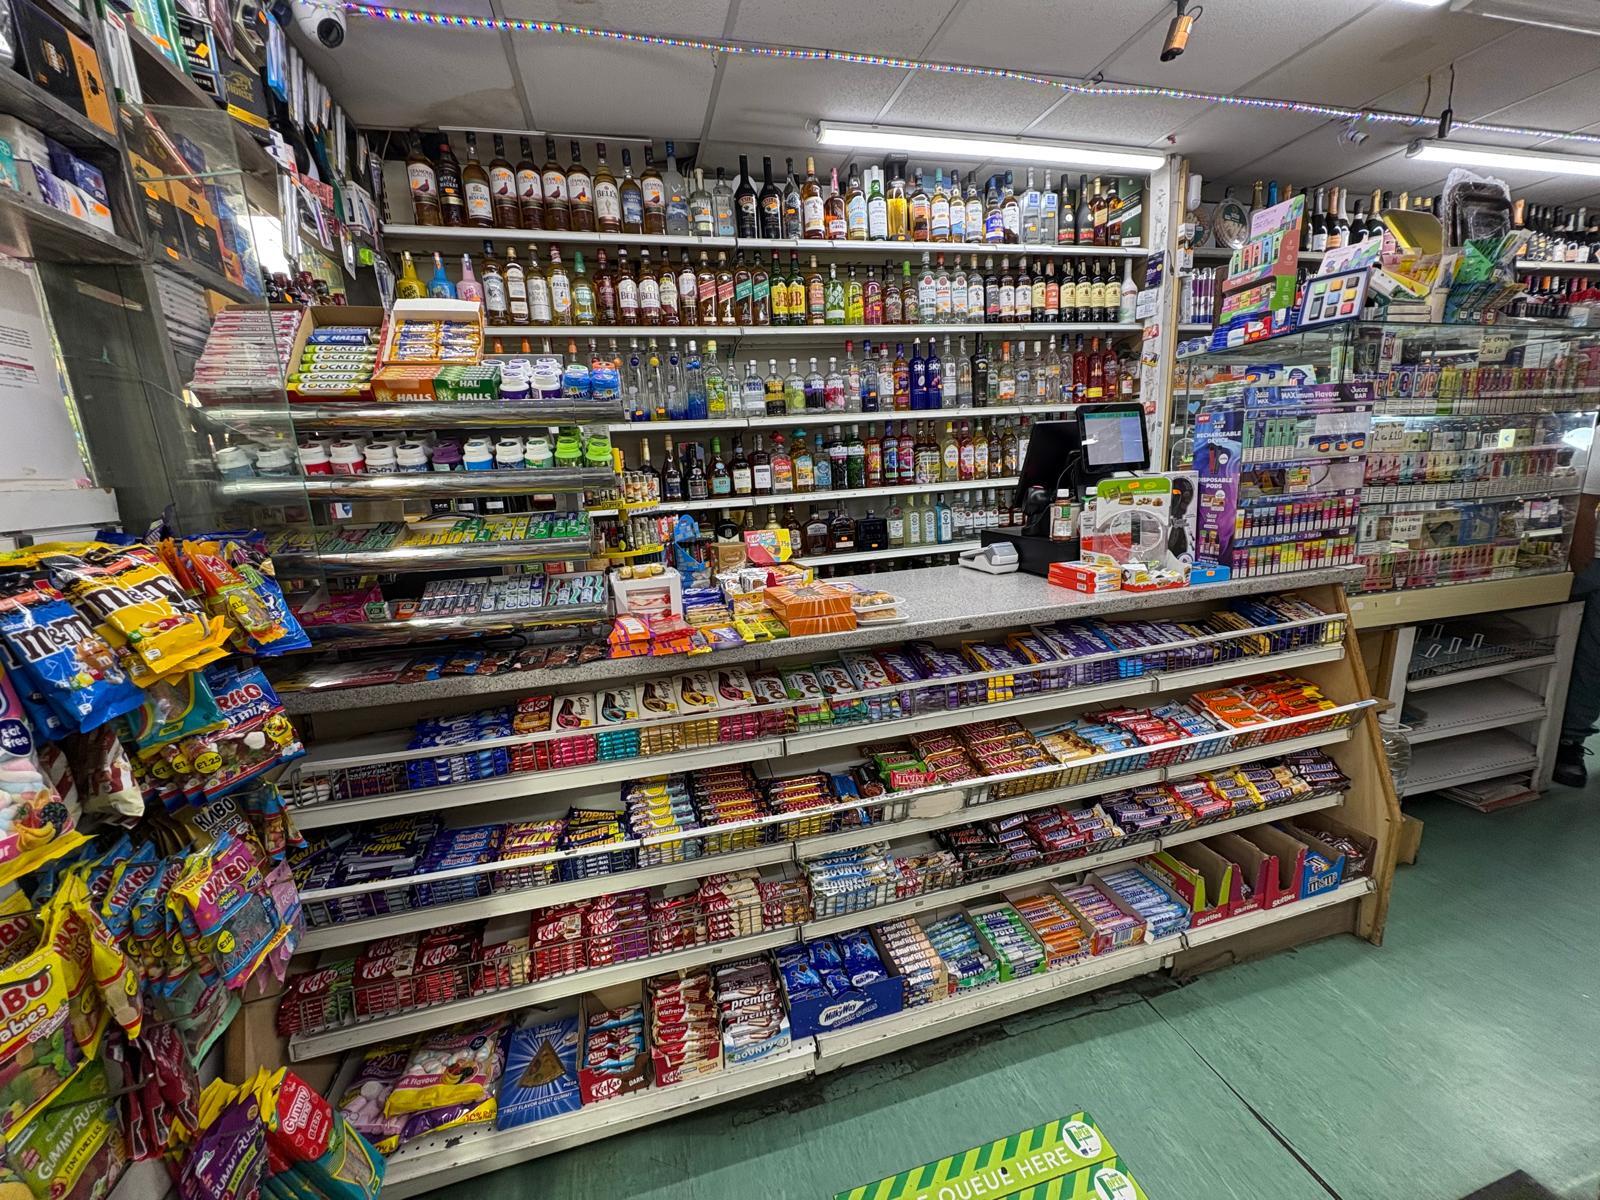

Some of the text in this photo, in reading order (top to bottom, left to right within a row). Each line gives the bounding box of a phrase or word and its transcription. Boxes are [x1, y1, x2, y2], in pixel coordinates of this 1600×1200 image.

[332, 334, 363, 342] HALLS
[316, 353, 364, 361] LOCKETS
[313, 363, 361, 371] LOCKETS
[304, 373, 354, 381] LOCKETS
[397, 393, 432, 401] HALLS
[215, 684, 263, 711] RIBO
[976, 740, 1006, 755] Twix
[195, 755, 221, 769] £1.25
[936, 755, 962, 767] Twix
[984, 751, 1017, 767] Twix
[899, 773, 923, 784] Twix
[704, 781, 748, 791] crunchie
[778, 787, 822, 799] crunchie
[1225, 788, 1247, 799] SNICKERS
[1264, 790, 1292, 800] SNICKERS
[711, 801, 758, 813] crunchie
[718, 812, 765, 825] crunchie
[568, 826, 609, 840] YORKIE
[999, 829, 1024, 841] SNICKERS
[1011, 849, 1037, 860] SNICKERS
[1272, 893, 1296, 907] Skittles
[983, 911, 1003, 920] POLO
[1197, 913, 1223, 926] Skittles
[540, 922, 567, 940] KitKat
[1051, 920, 1079, 932] mentos
[886, 929, 911, 940] SMARTIES
[993, 928, 1014, 937] POLO
[891, 936, 916, 947] SMARTIES
[424, 945, 457, 964] KitKat
[895, 945, 921, 956] SMARTIES
[899, 953, 926, 964] SMARTIES
[1051, 950, 1090, 965] mentos
[363, 956, 400, 977] KitKat
[301, 970, 338, 993] KitKat
[655, 996, 679, 1006] Wafreta
[731, 992, 776, 1009] premier
[658, 1007, 685, 1016] Wafreta
[0, 1004, 47, 1042] abies
[659, 1026, 687, 1035] Wafreta
[734, 1041, 773, 1061] BOUNTY
[592, 1078, 622, 1097] KitKat
[628, 1075, 645, 1087] DARK
[518, 1103, 537, 1111] FLAVOR
[538, 1098, 553, 1106] GIANT
[554, 1092, 573, 1102] GUMMY
[283, 1086, 310, 1134] Gummy
[308, 1109, 322, 1140] BELTS
[37, 1127, 75, 1180] GUMMY
[938, 1147, 1073, 1200] QUEUE HERE
